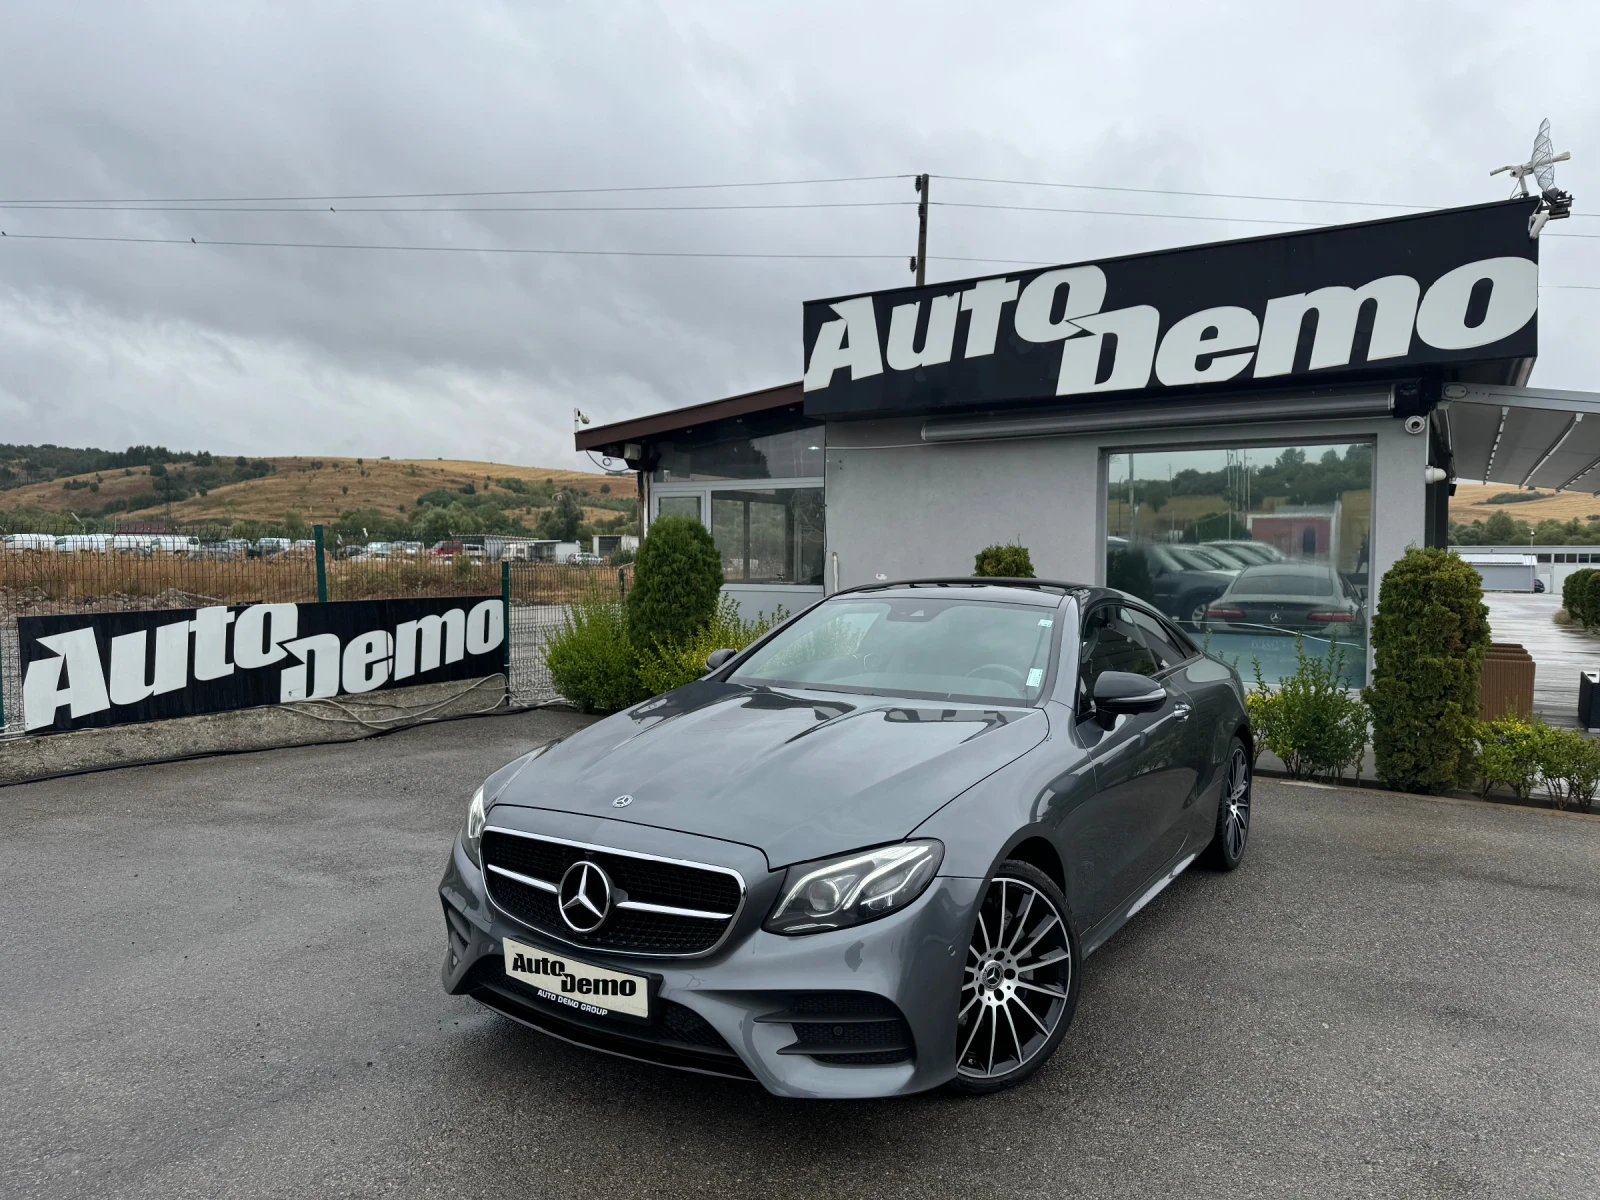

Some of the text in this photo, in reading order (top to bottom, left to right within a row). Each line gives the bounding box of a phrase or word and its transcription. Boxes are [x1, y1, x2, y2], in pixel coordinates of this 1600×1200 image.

[804, 264, 1107, 391] Auto
[1055, 256, 1538, 396] Demo
[24, 602, 299, 732] Auto
[280, 599, 504, 703] Demo
[512, 953, 566, 976] Auto
[537, 989, 608, 1016] AUTO DEMO GROUP
[561, 973, 637, 996] Demo
